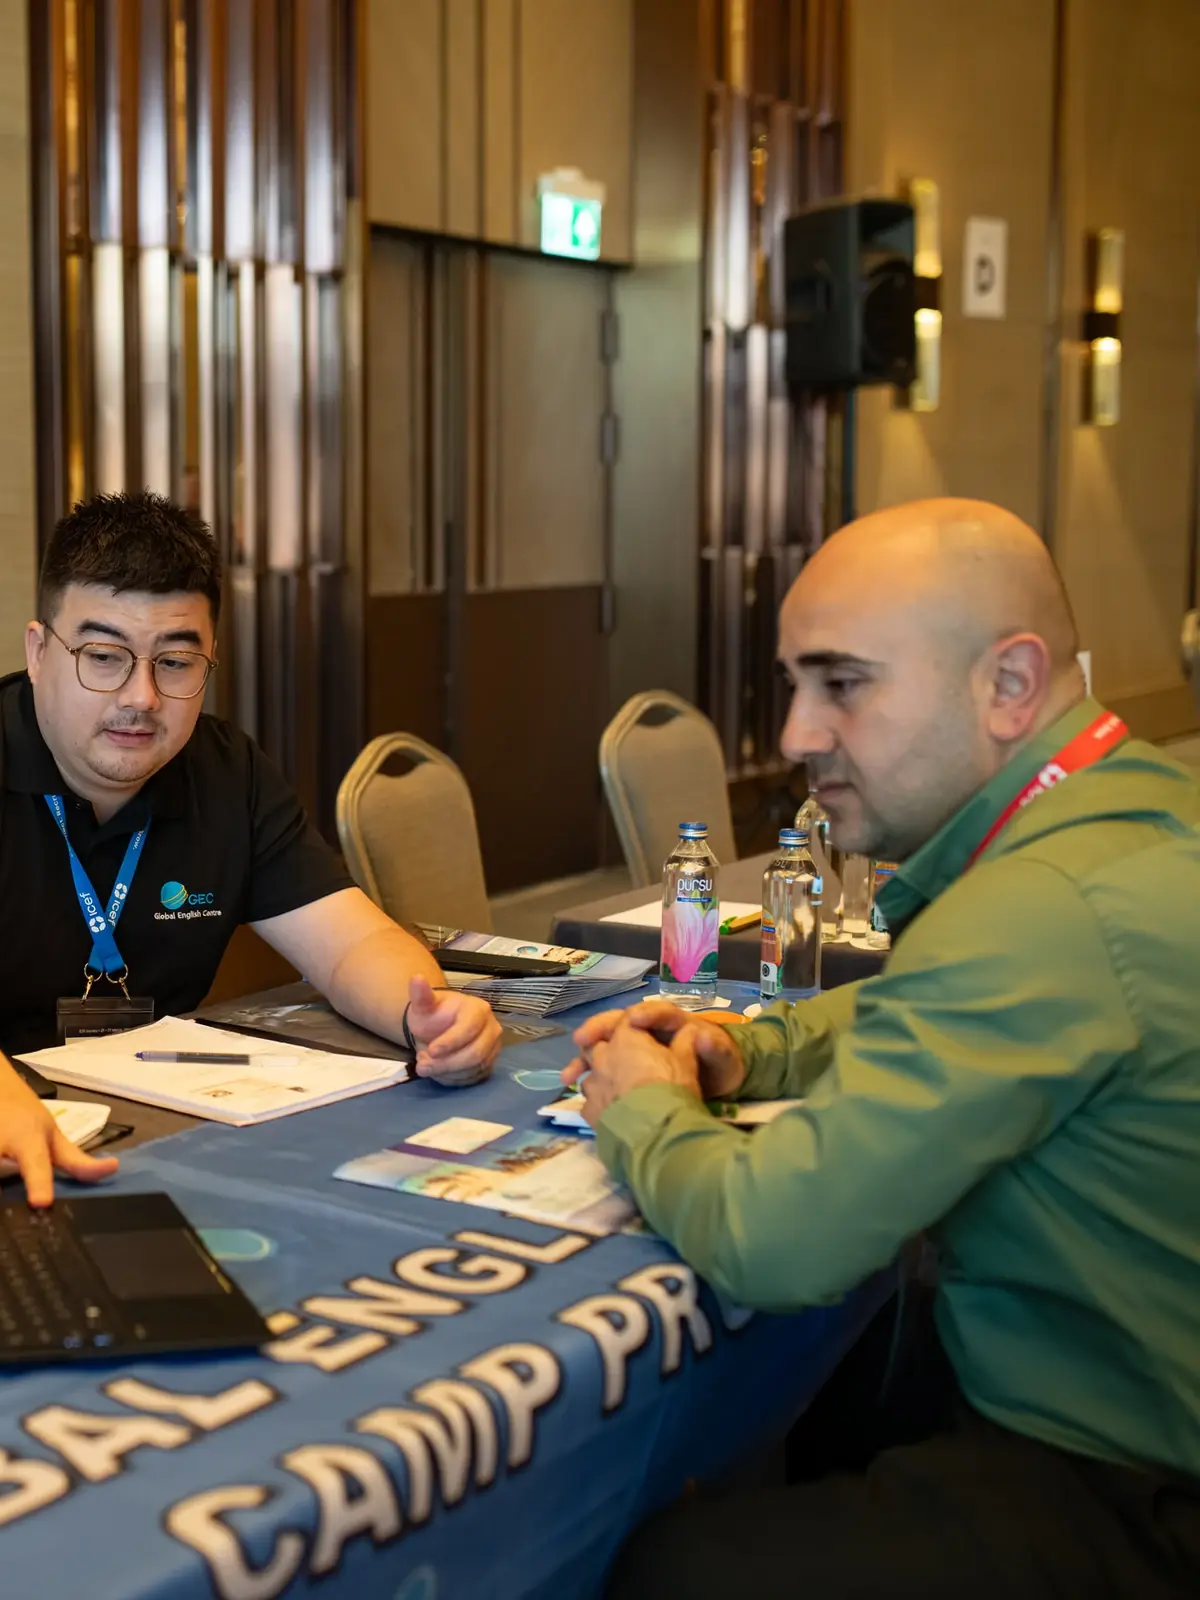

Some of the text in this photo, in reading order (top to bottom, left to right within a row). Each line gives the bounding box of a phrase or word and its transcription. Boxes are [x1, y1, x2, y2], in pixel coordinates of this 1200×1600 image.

[187, 892, 214, 905] GEC
[153, 909, 222, 920] Global English Centre
[163, 1261, 714, 1600] CAMP PR
